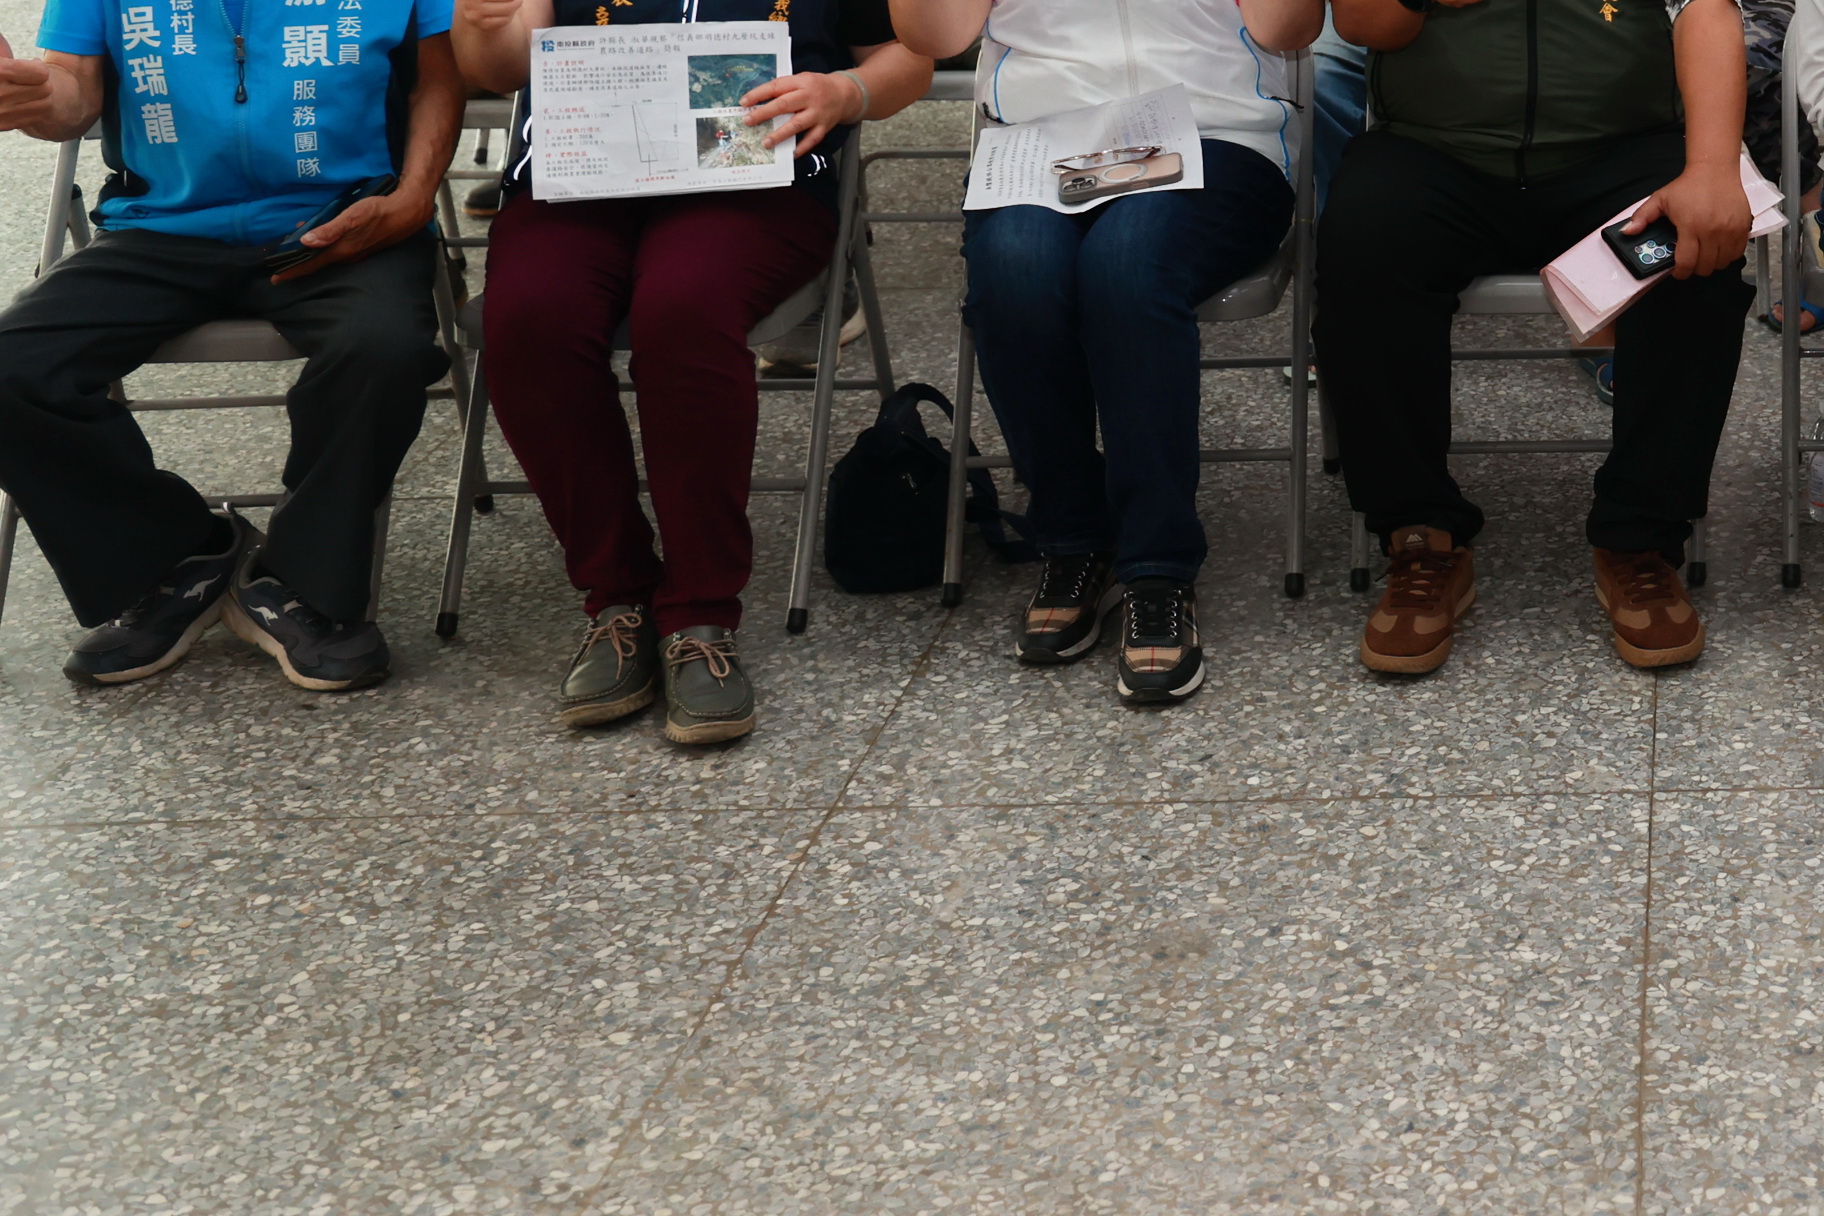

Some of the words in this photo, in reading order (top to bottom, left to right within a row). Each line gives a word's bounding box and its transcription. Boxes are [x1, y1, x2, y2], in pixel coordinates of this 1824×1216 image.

[122, 5, 178, 145] 吳瑞龍
[292, 79, 321, 178] 服務團隊
